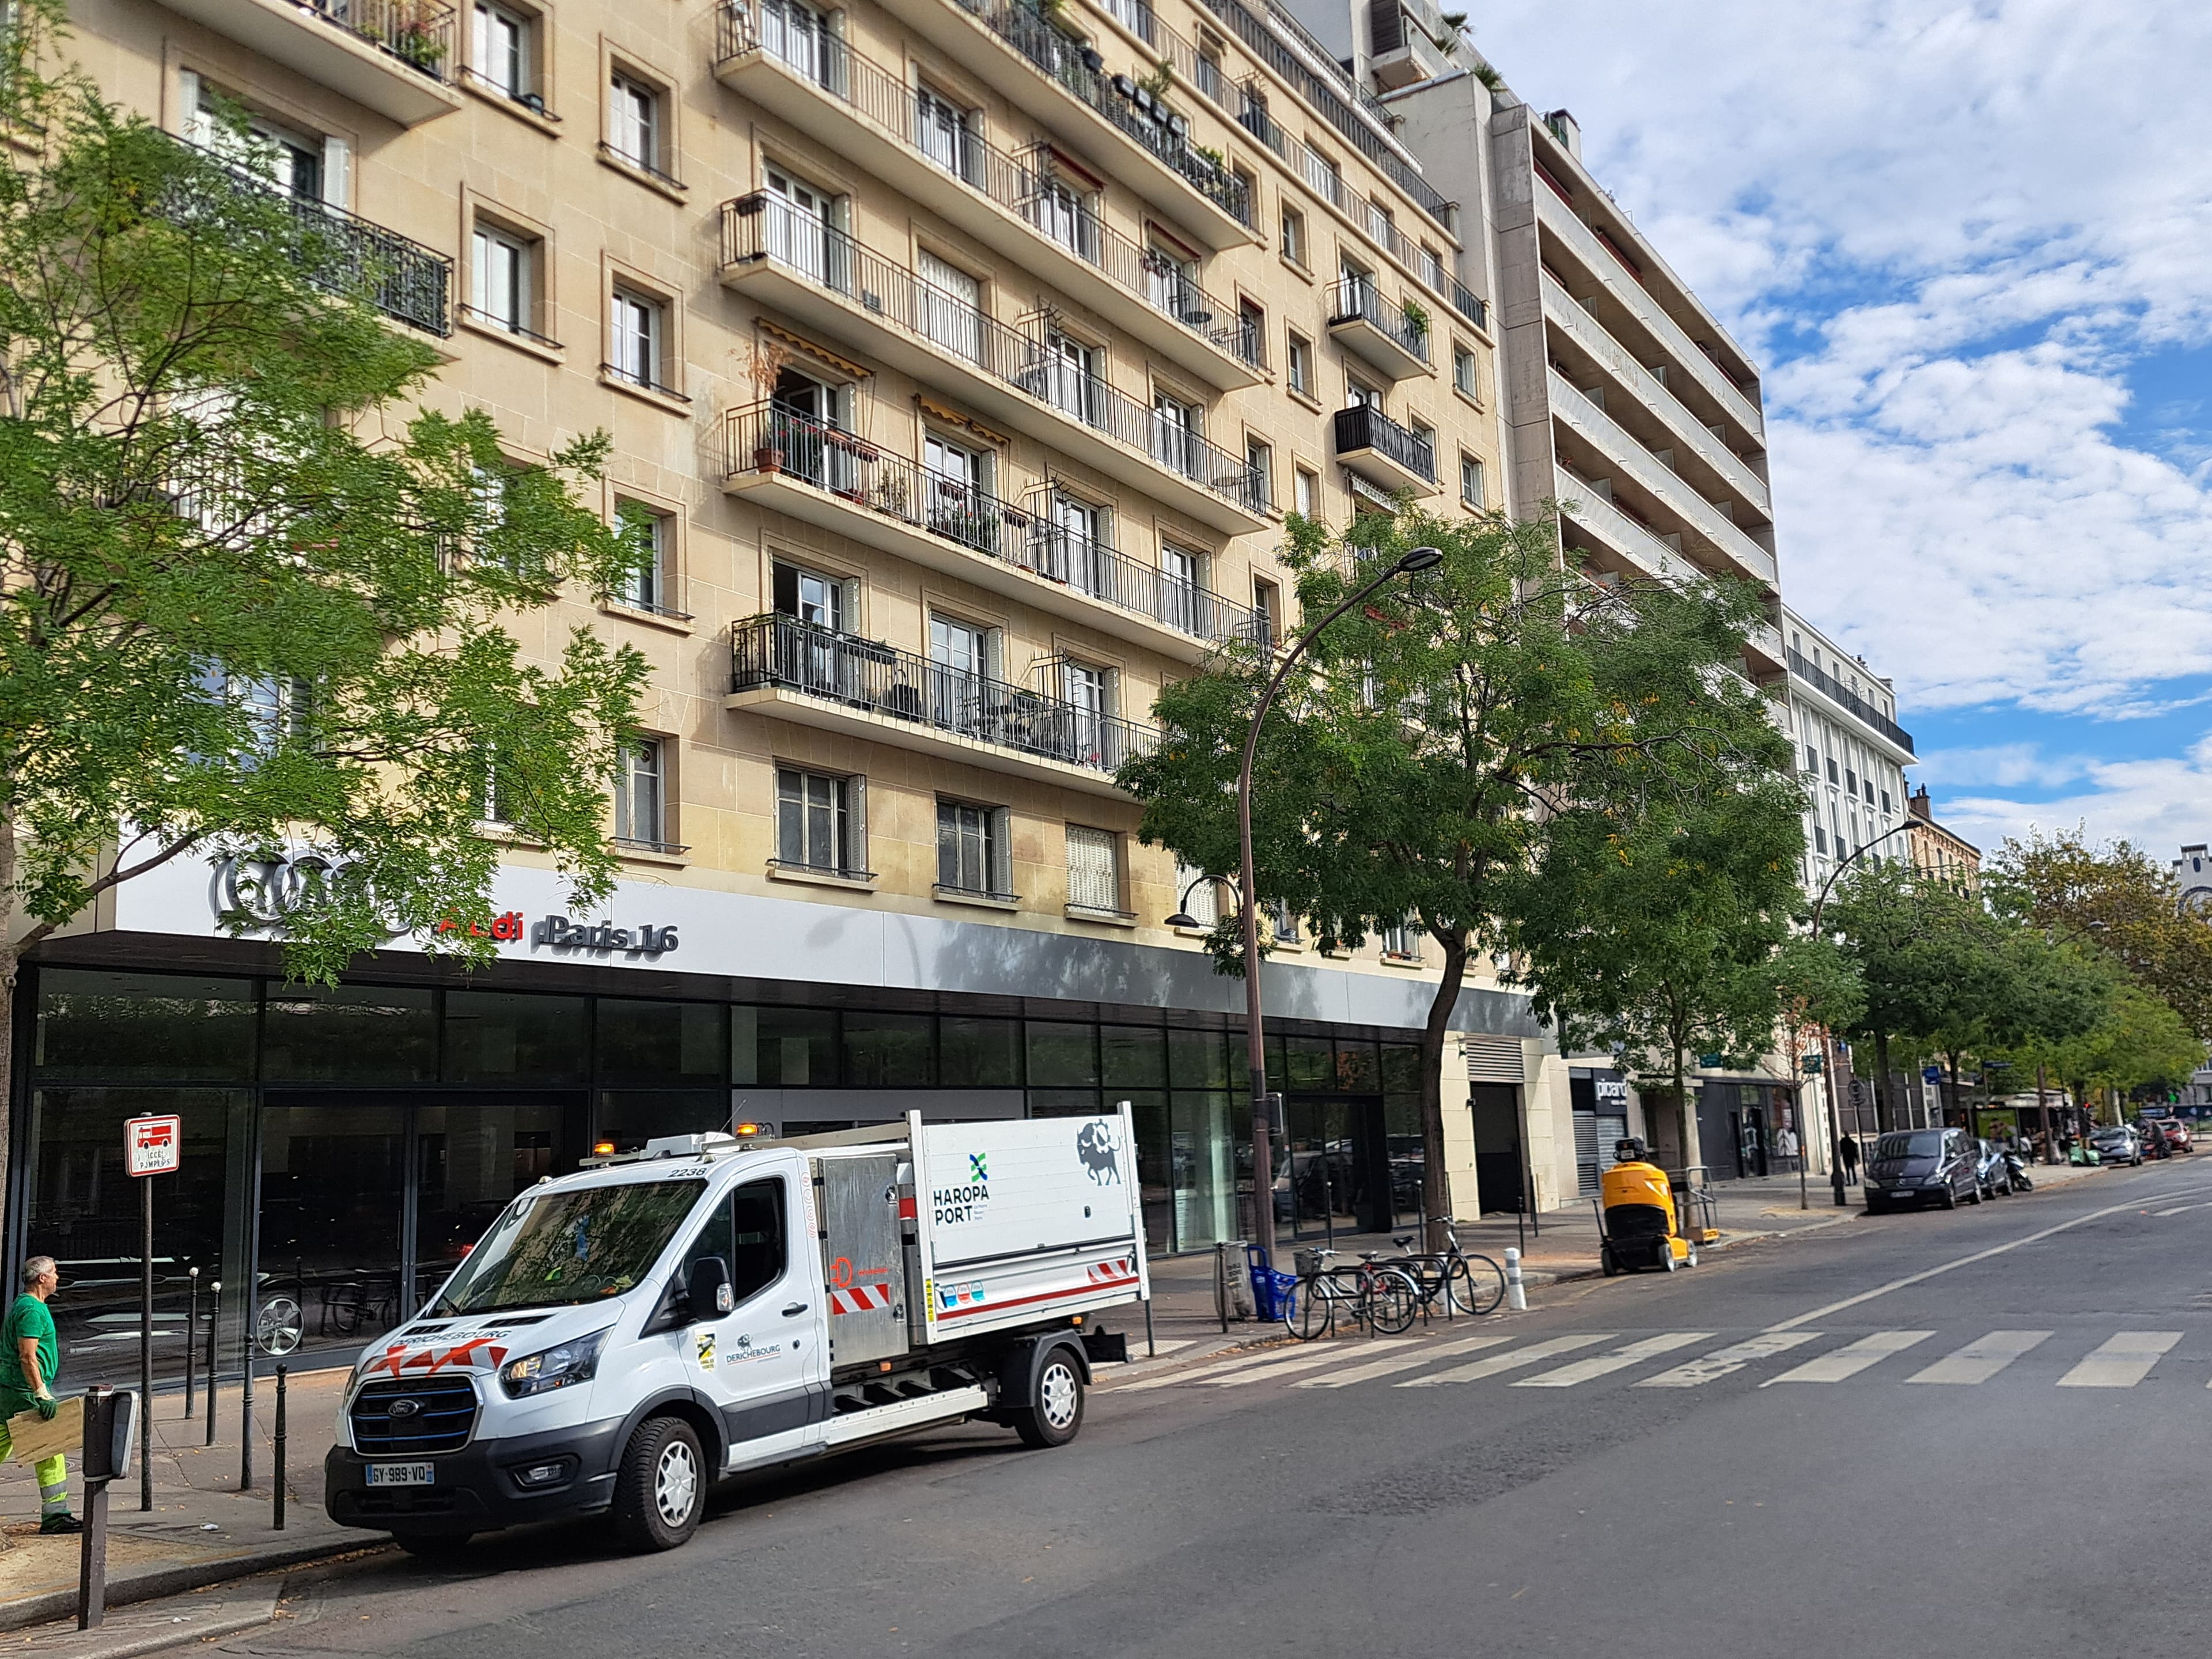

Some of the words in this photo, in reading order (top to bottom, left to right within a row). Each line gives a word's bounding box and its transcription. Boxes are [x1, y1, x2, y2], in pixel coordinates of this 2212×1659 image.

[543, 915, 628, 949] Paris
[637, 924, 679, 952] 16
[1595, 1078, 1627, 1101] picard
[668, 1168, 707, 1178] 2238
[933, 1185, 990, 1206] HAROPA
[935, 1205, 973, 1226] PORT
[726, 1344, 781, 1363] DERICHEBOURG
